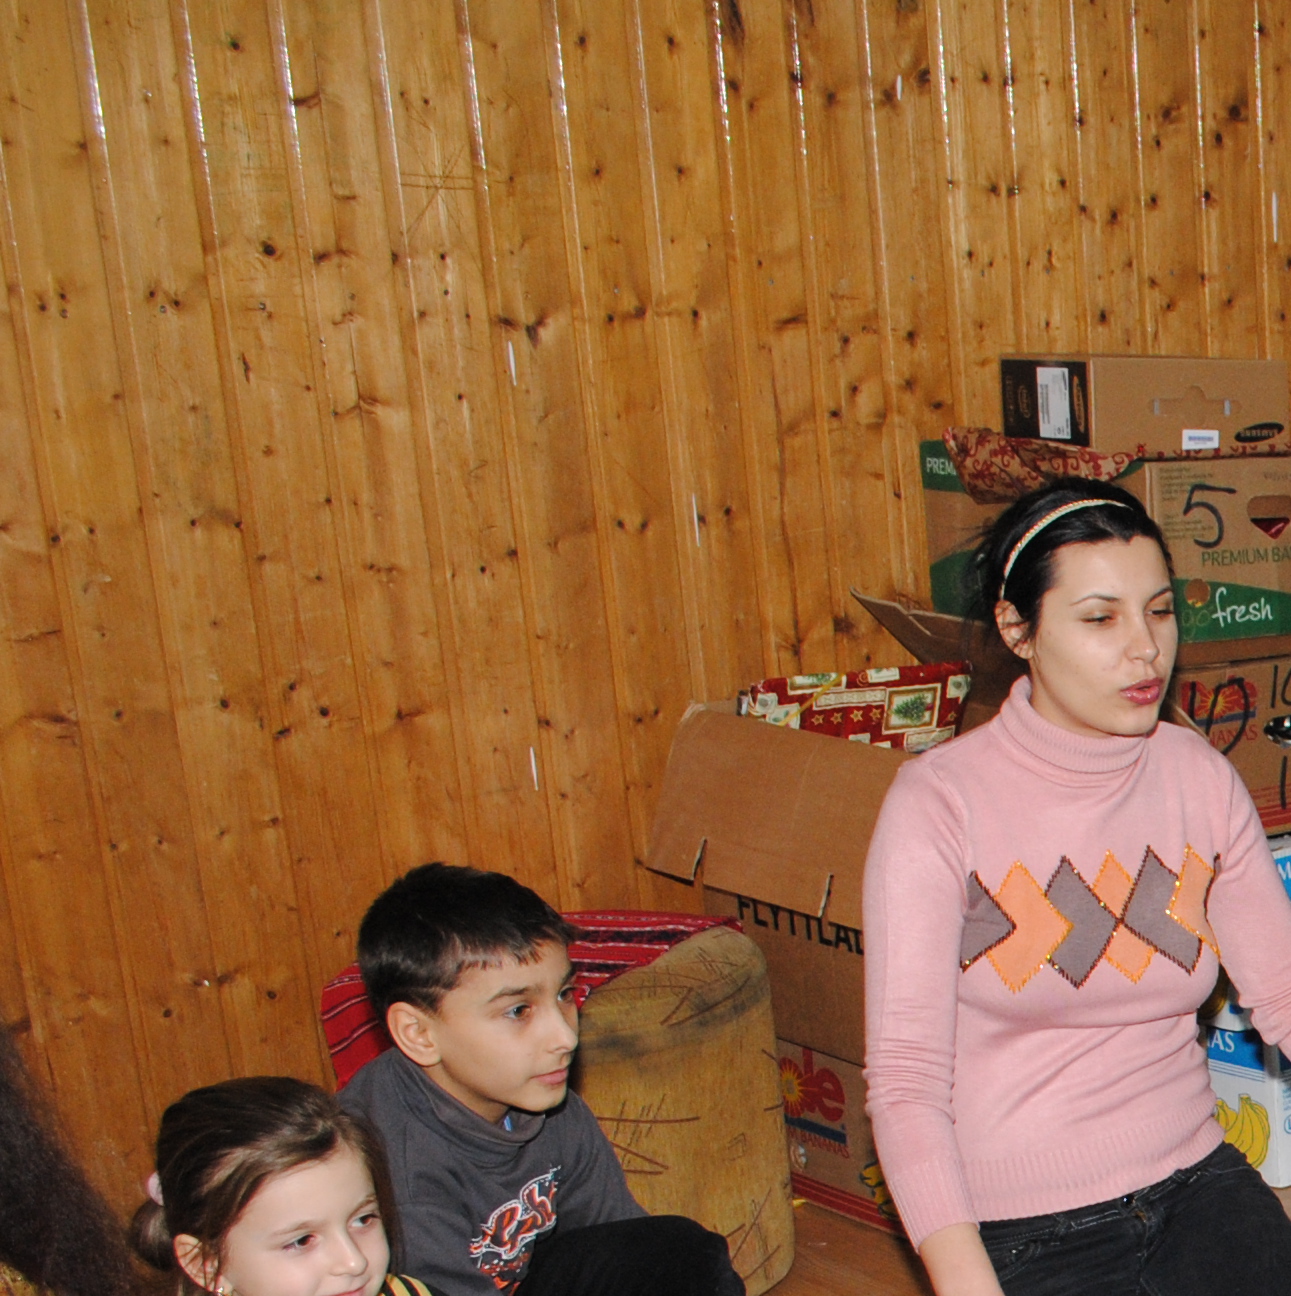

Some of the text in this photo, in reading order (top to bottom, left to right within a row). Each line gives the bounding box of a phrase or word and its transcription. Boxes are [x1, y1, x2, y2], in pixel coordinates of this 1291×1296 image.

[926, 457, 957, 476] PREM
[1183, 484, 1236, 549] 5
[1202, 549, 1268, 567] PREMIUM
[1211, 586, 1273, 628] fresh
[780, 1047, 846, 1122] ole
